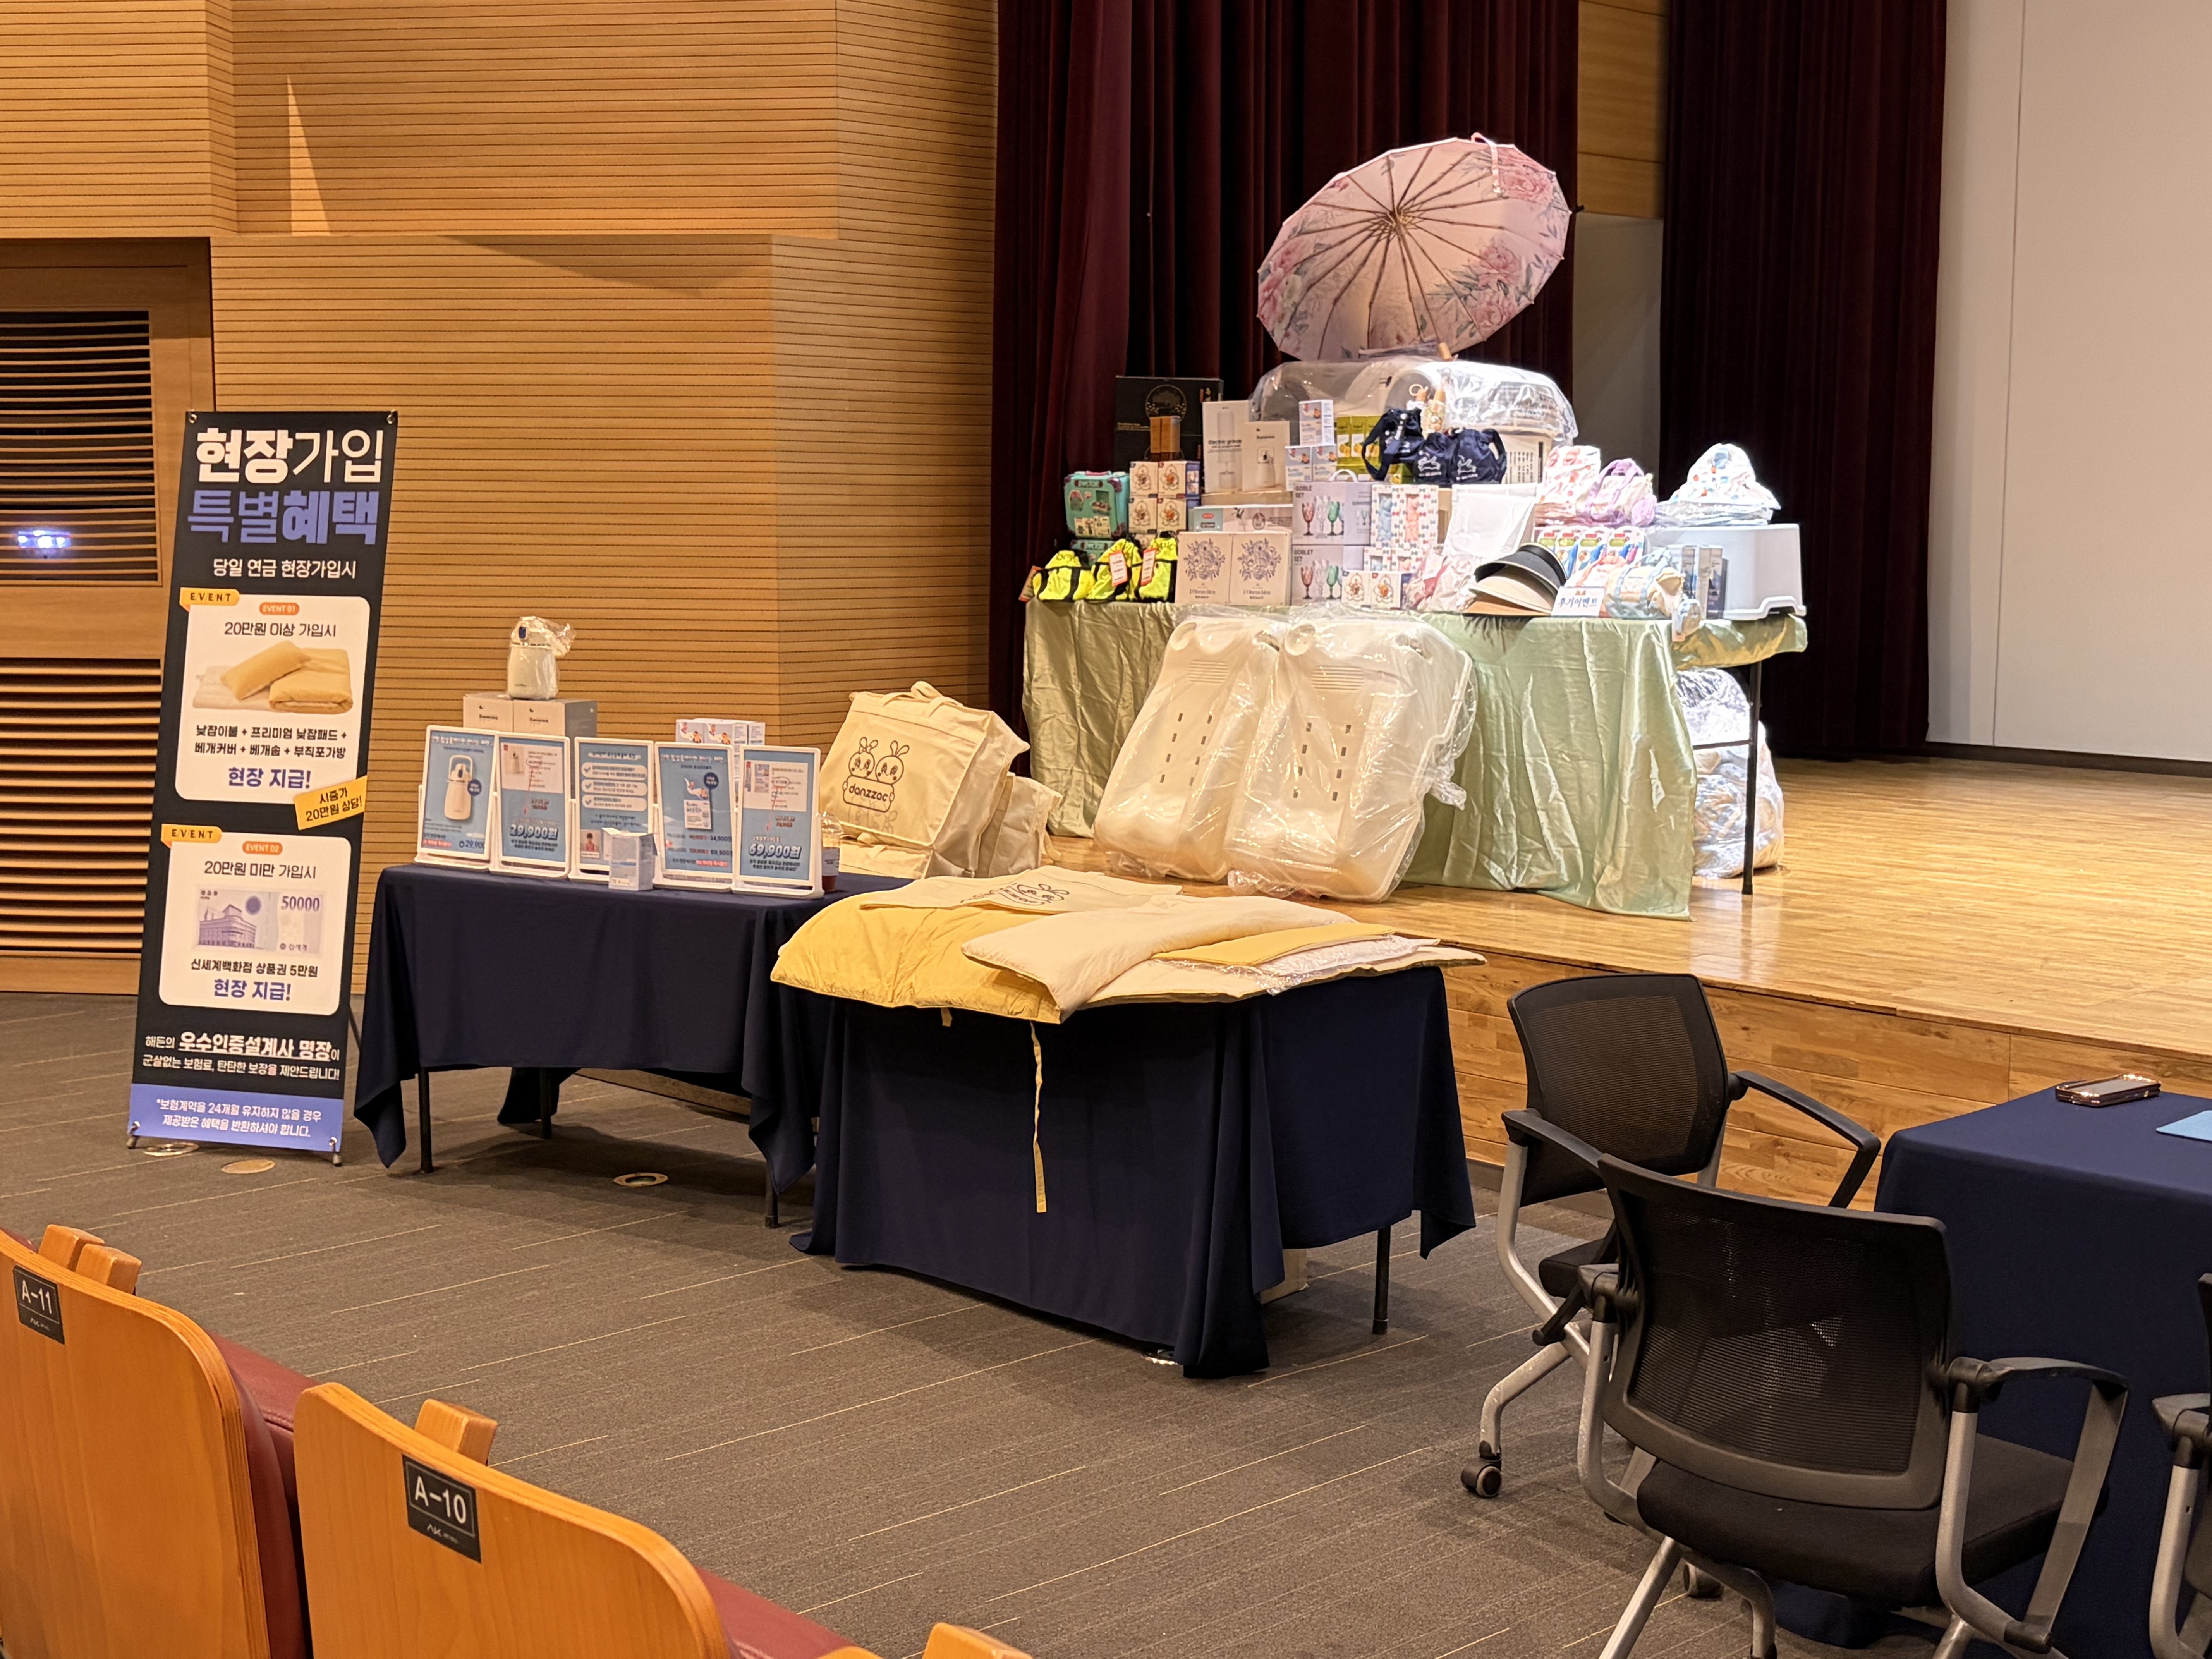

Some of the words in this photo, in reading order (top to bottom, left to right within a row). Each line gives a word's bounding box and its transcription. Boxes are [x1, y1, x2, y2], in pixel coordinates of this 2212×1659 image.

[196, 428, 383, 483] 현장가입
[188, 490, 380, 545] 특별혜택
[213, 558, 243, 577] 당일
[247, 559, 277, 577] 연금
[281, 560, 357, 579] 현장가입시
[224, 622, 266, 636] 20만원
[271, 623, 295, 636] 이상
[299, 623, 337, 637] 가입시
[196, 725, 238, 737] 낮잠이불
[251, 726, 293, 739] 프리미엄
[296, 728, 338, 740] 낮잠패드
[194, 742, 237, 755] 베개커버
[249, 744, 280, 756] 베개솜
[294, 745, 347, 759] 부직포가방
[228, 767, 264, 787] 현장
[269, 769, 311, 789] 지급!
[319, 787, 348, 804] 시중가
[305, 803, 339, 822] 20만원
[510, 824, 559, 840] 29,900원
[246, 843, 269, 852] EVENT
[270, 845, 279, 853] 02
[749, 843, 802, 860] 69,900원
[204, 860, 246, 876] 20만원
[249, 863, 275, 877] 미만
[278, 864, 316, 879] 가입시
[280, 896, 320, 912] 50000
[191, 958, 252, 974] 신세계백화점
[256, 962, 287, 975] 상품권
[290, 965, 318, 977] 5만원
[214, 979, 247, 998] 현장
[252, 981, 292, 1001] 지급!
[145, 1035, 175, 1049] 해든의
[179, 1031, 295, 1058] 우수인증설계사
[299, 1040, 340, 1061] 명장이
[143, 1054, 182, 1069] 군살없는
[183, 1058, 215, 1072] 보험료,
[217, 1060, 247, 1073] 탄탄한
[248, 1062, 277, 1076] 보장을
[280, 1064, 340, 1080] 제안드립니다!
[208, 1103, 240, 1116] 24개월
[242, 1105, 279, 1119] 유지하지
[282, 1108, 300, 1120] 않을
[303, 1109, 322, 1122] 경우
[163, 1114, 199, 1128] 제공받은
[201, 1118, 229, 1130] 혜택을
[231, 1120, 278, 1135] 반환하셔야
[280, 1123, 311, 1137] 합니다.
[22, 1279, 52, 1314] A-11
[415, 1475, 467, 1524] A-10
